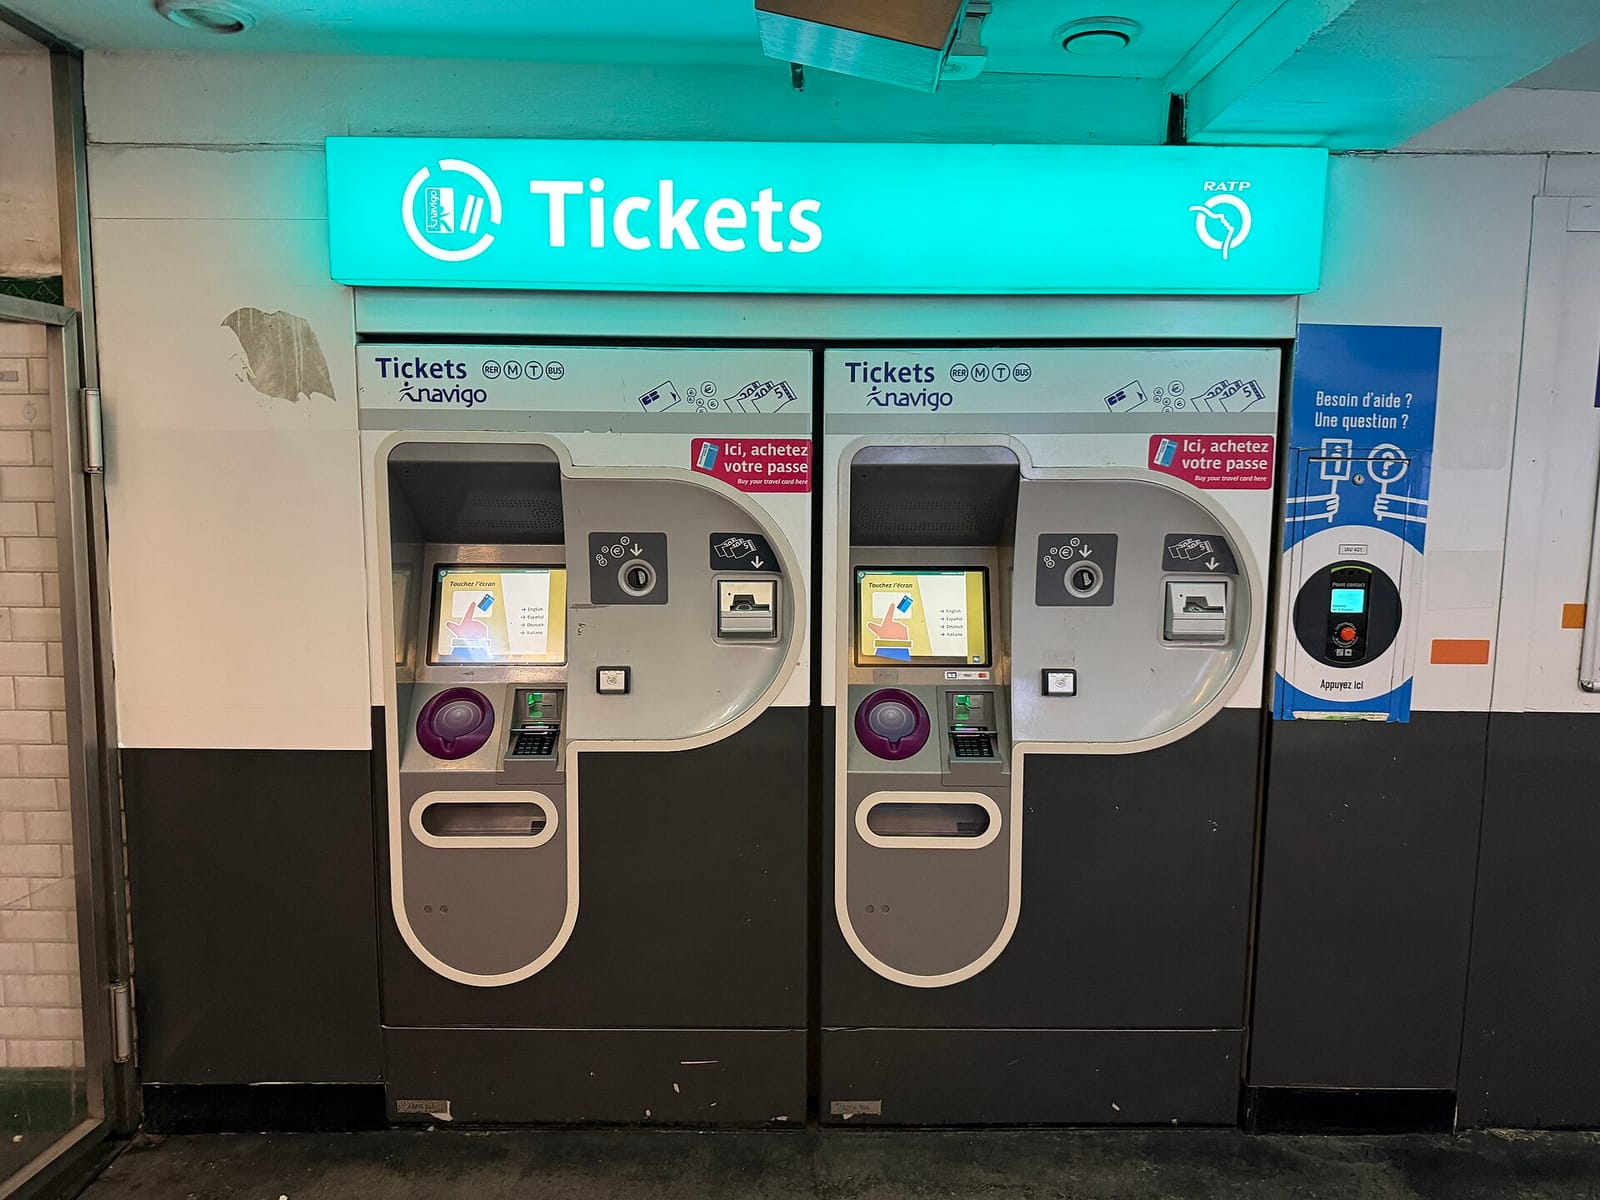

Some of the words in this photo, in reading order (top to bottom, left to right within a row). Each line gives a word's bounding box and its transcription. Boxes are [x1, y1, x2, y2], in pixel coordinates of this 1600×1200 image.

[1203, 181, 1251, 192] RATP
[530, 178, 822, 253] Tickets
[375, 357, 467, 379] Tickets
[845, 361, 935, 383] Tickets
[415, 384, 487, 407] navigo
[774, 386, 783, 399] 5
[1242, 386, 1252, 398] 5
[882, 388, 953, 411] navigo
[1316, 391, 1358, 407] Besoin
[1362, 392, 1401, 408] d'aide
[1405, 393, 1413, 408] ?
[1314, 412, 1338, 427] Une
[1342, 414, 1397, 431] question
[1401, 413, 1409, 429] ?
[724, 443, 747, 458] Ici,
[751, 443, 808, 456] achetez
[1183, 440, 1206, 454] Ici,
[1210, 440, 1269, 453] achetez
[724, 462, 762, 473] votre
[767, 462, 808, 475] passe
[1182, 459, 1222, 470] votre
[1226, 459, 1268, 472] passe
[737, 478, 749, 486] Buy
[1320, 679, 1352, 691] Appuyez
